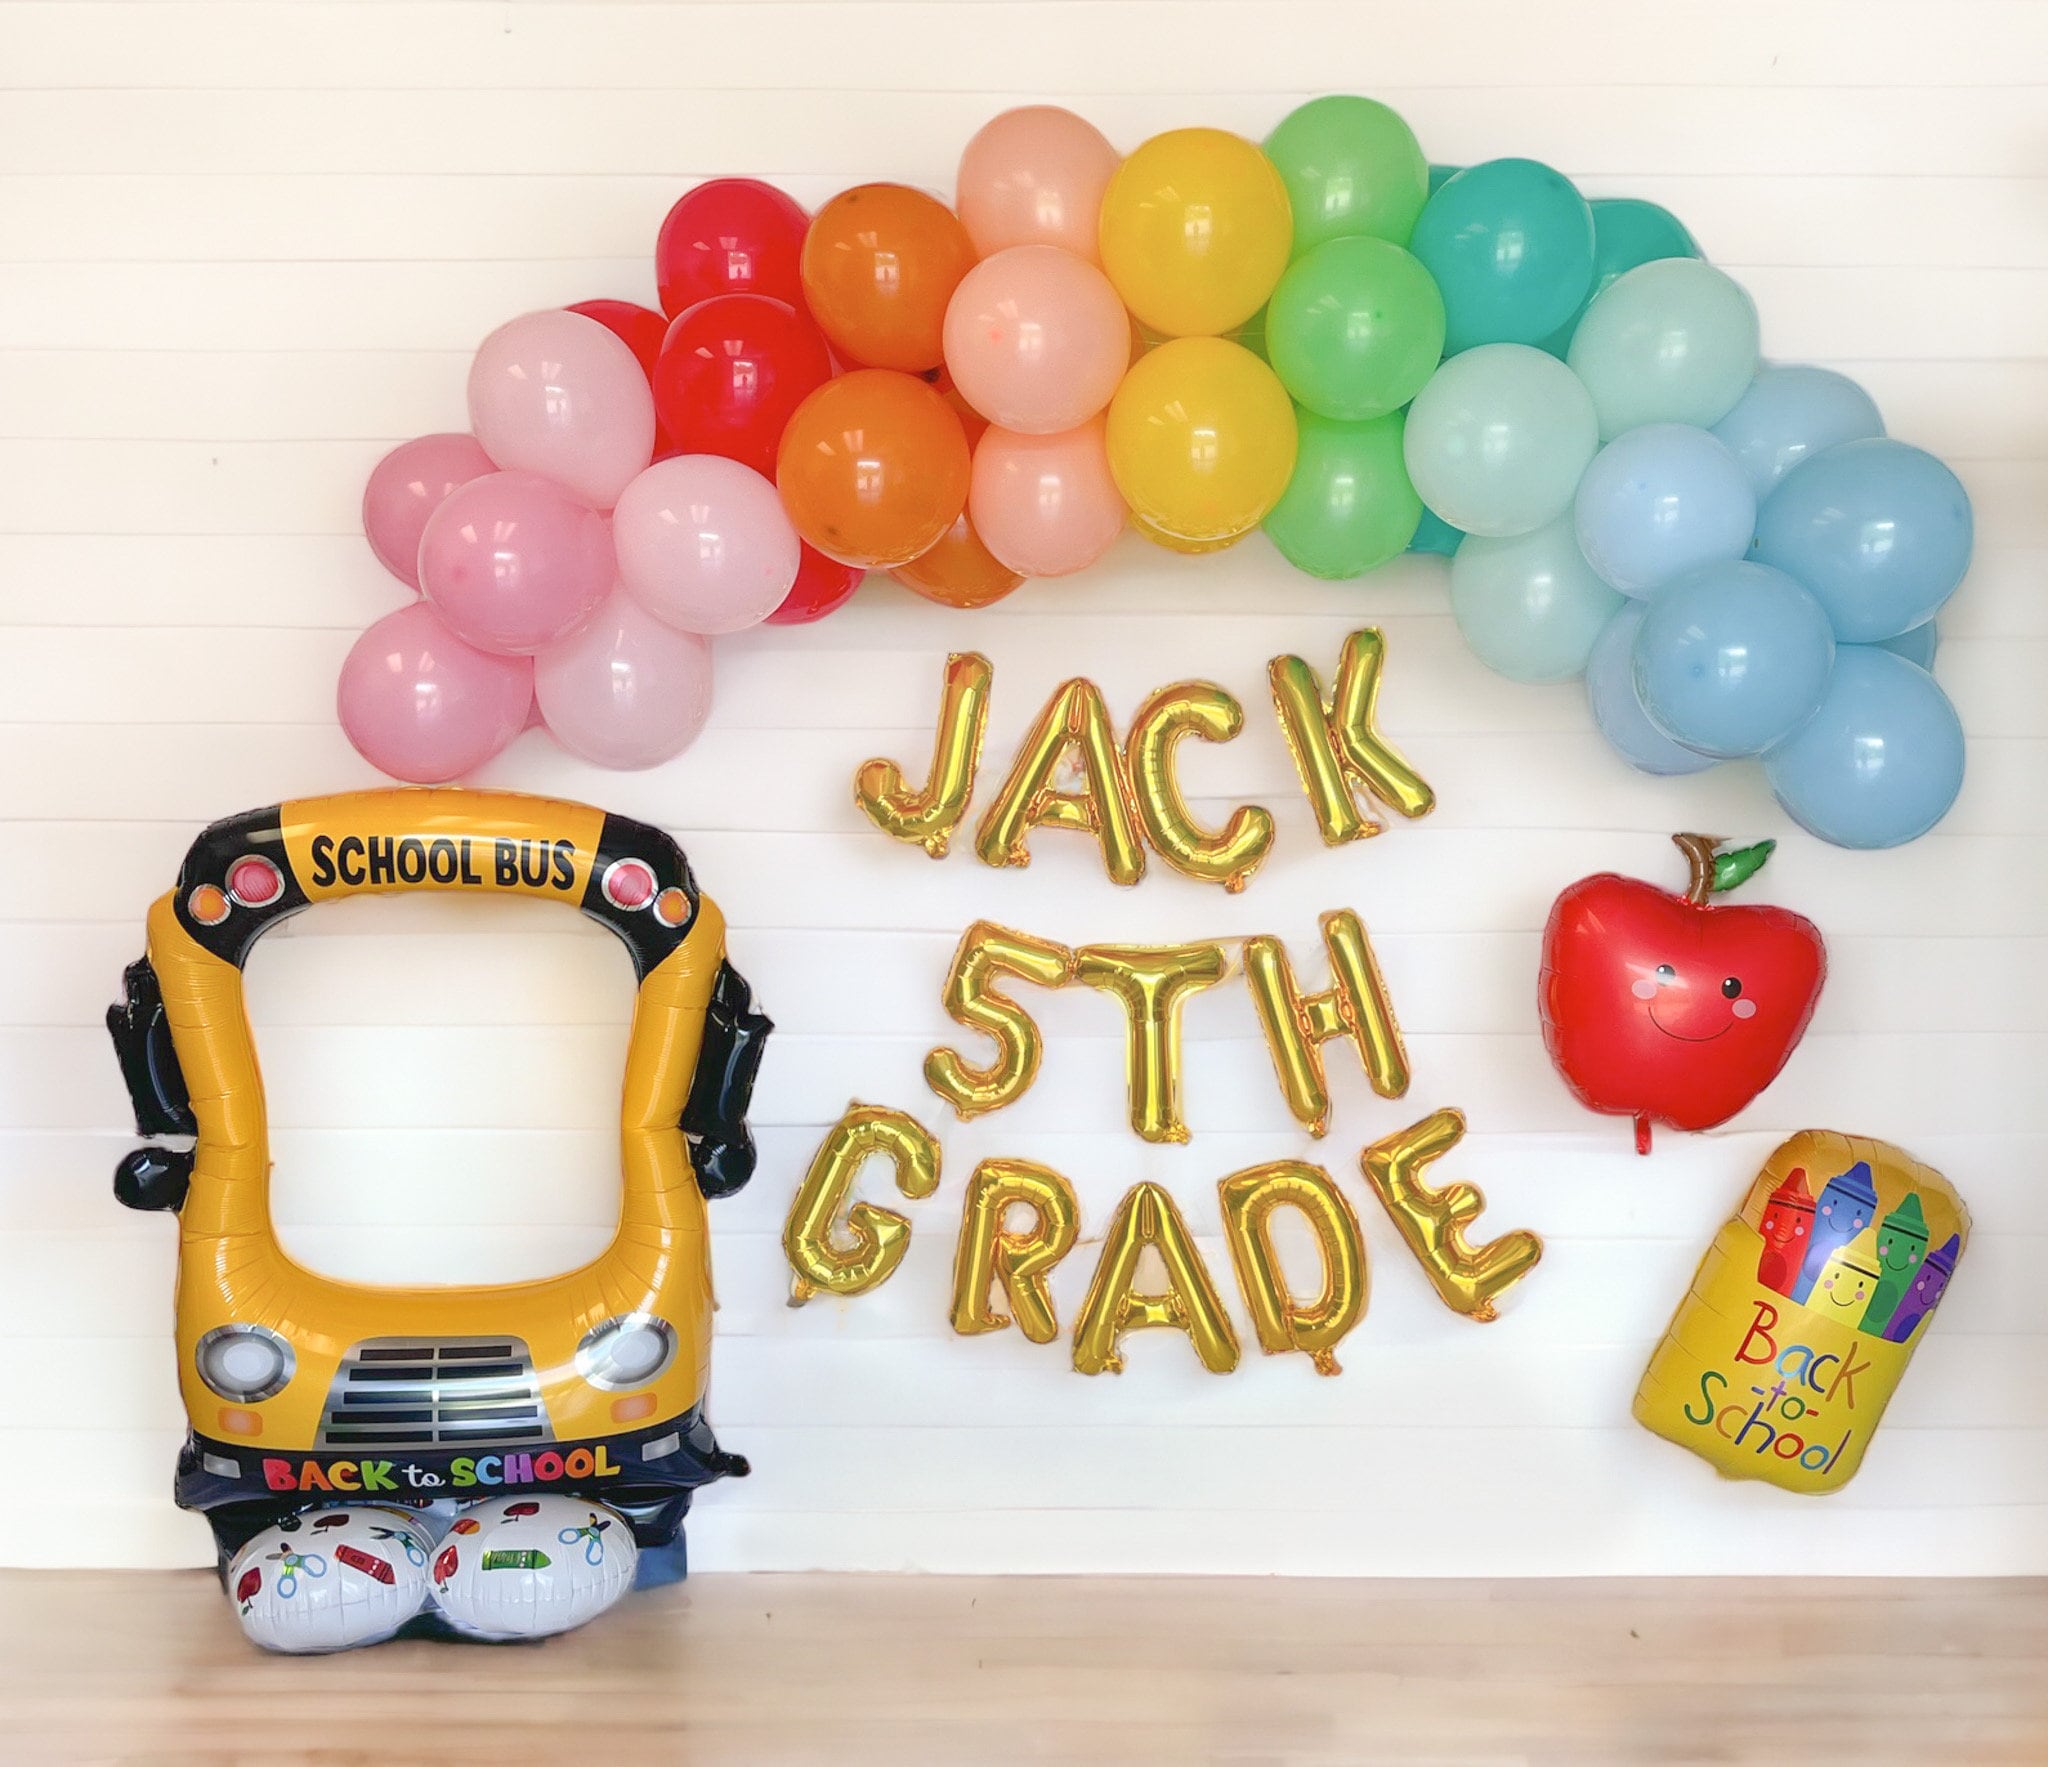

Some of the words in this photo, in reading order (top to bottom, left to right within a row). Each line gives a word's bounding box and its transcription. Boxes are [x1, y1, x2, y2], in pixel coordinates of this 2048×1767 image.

[854, 627, 1436, 894] JACK
[311, 835, 482, 886] SCHOOL
[494, 837, 576, 889] BUS
[923, 907, 1410, 1144] 5TH
[784, 1103, 1544, 1377] GRADE
[1734, 1300, 1870, 1410] Back
[263, 1458, 399, 1491] BACK
[402, 1464, 446, 1488] to
[450, 1445, 621, 1485] SCHOOL
[1684, 1370, 1852, 1475] School
